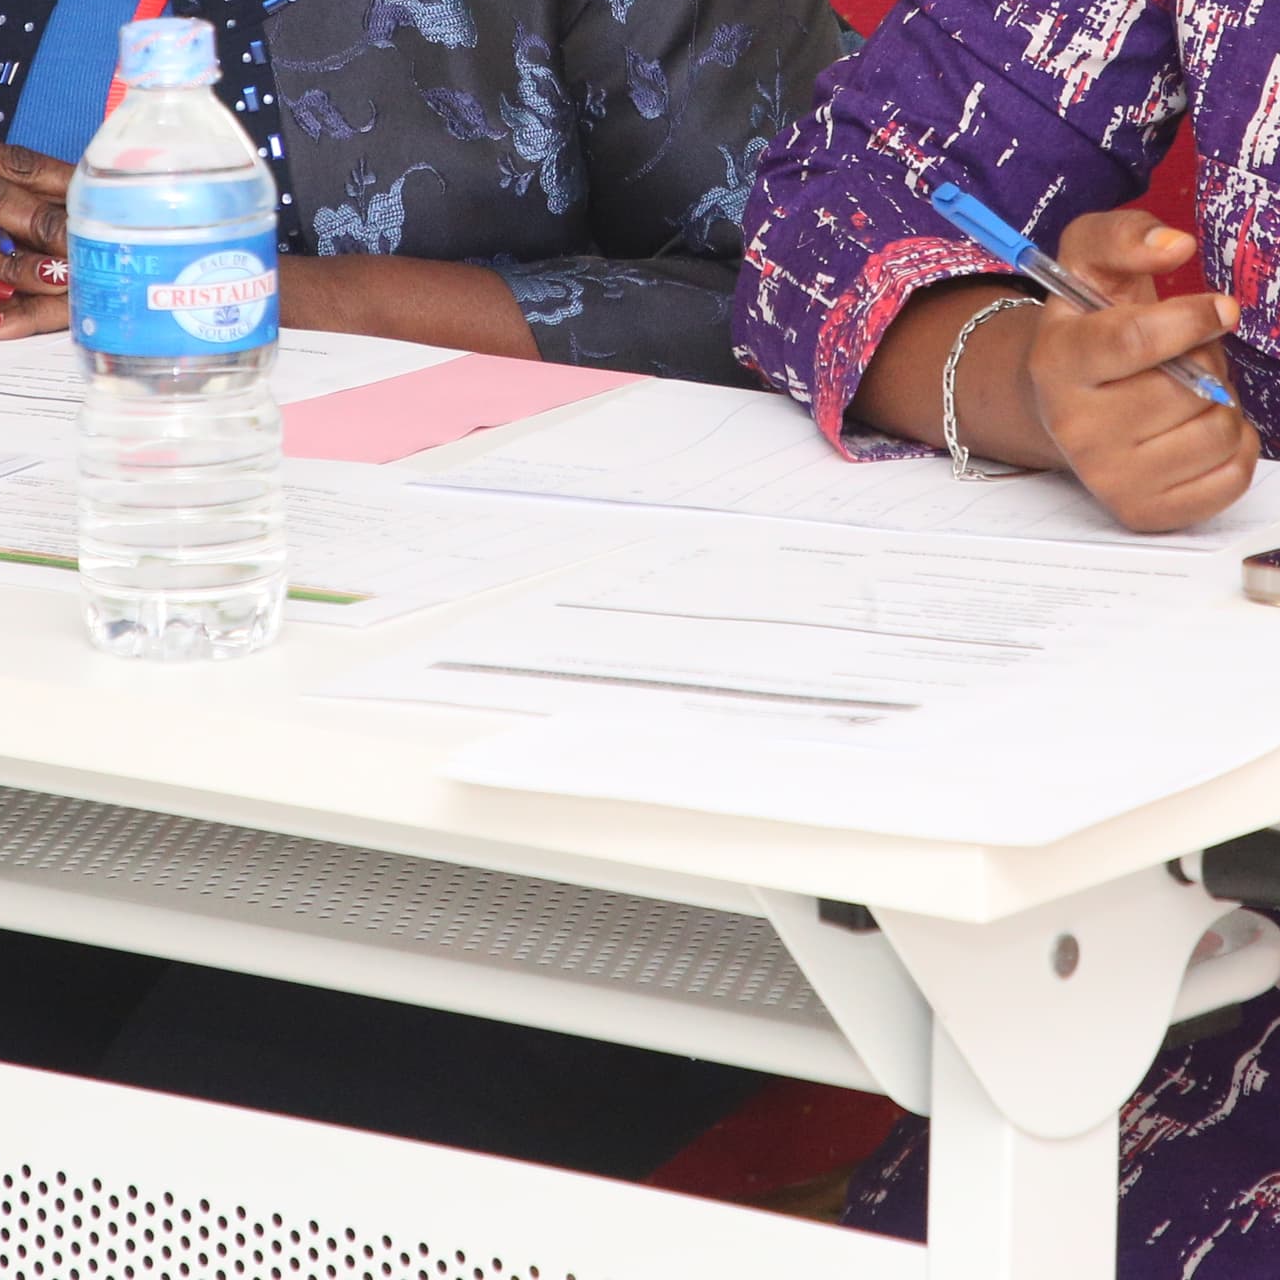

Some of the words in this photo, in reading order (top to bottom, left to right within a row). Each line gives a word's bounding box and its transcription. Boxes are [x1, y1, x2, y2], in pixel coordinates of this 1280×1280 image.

[73, 247, 161, 276] TALINE
[233, 254, 249, 266] DE
[151, 273, 275, 308] CRISTALINE
